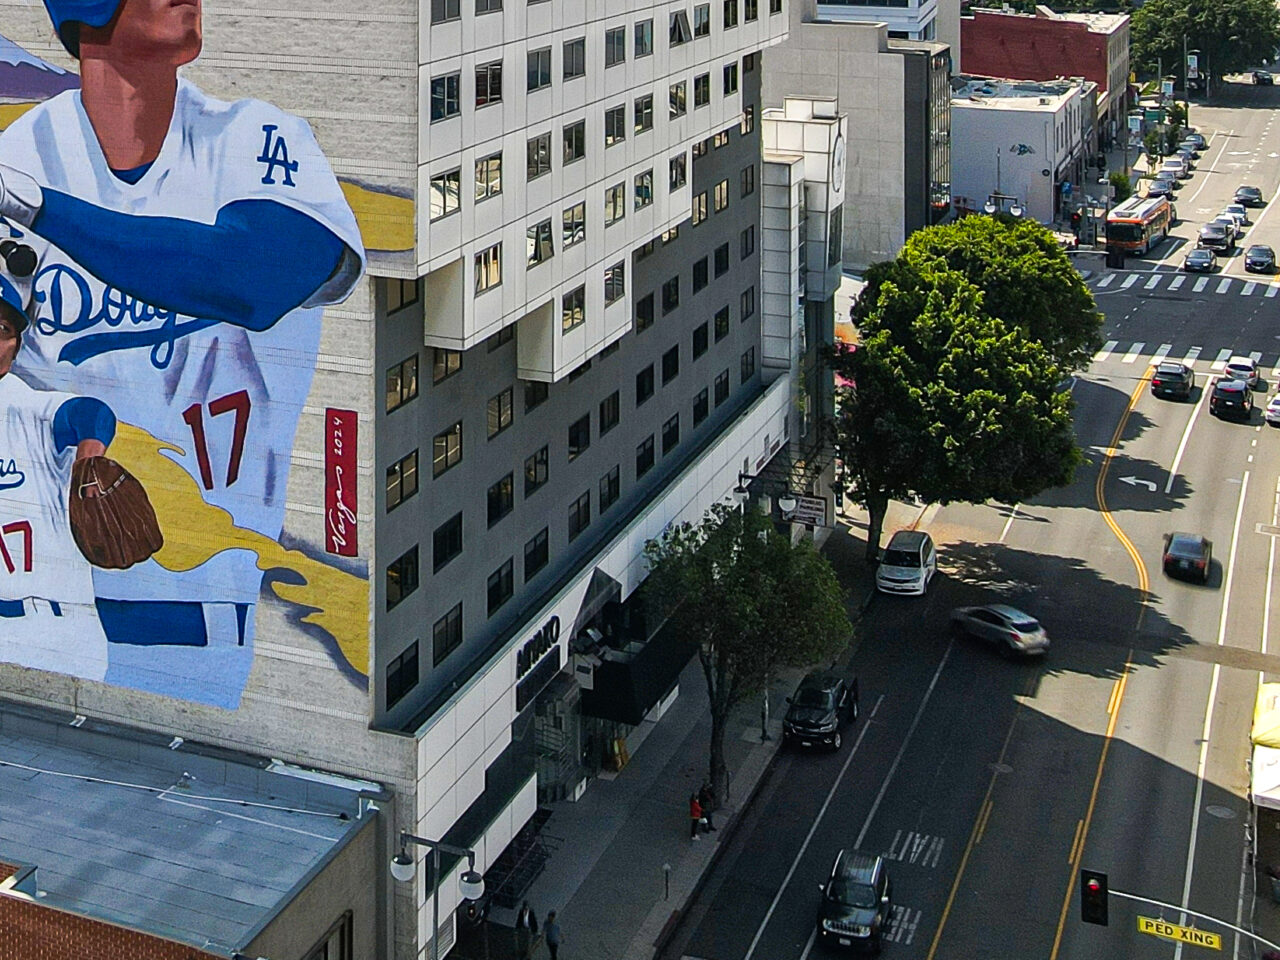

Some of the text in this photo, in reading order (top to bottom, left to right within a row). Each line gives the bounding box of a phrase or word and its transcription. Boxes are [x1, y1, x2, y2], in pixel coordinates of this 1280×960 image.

[256, 125, 299, 188] LA
[183, 389, 251, 491] 17
[329, 416, 357, 554] Vargas 2024
[1145, 921, 1214, 946] PED XING
